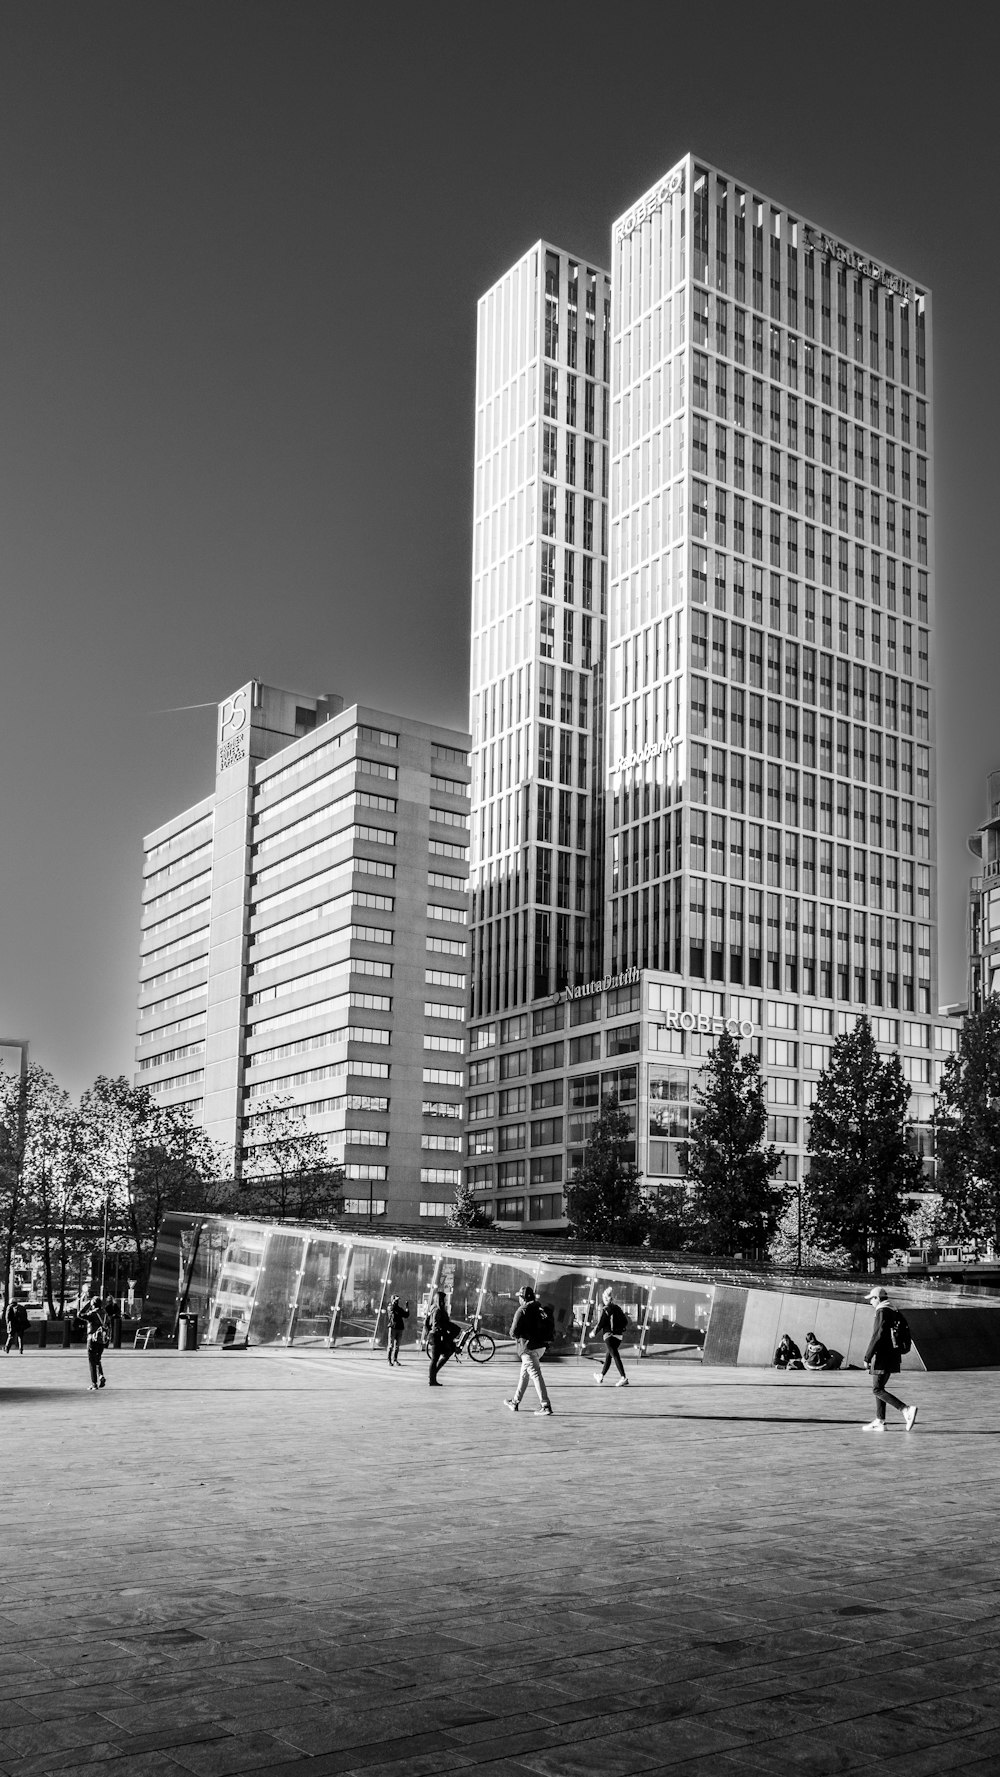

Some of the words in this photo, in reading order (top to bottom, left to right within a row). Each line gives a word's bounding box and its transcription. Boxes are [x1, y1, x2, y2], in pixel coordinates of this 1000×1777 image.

[614, 172, 683, 241] ROBECO
[565, 966, 640, 1001] NautaDutilh
[665, 1008, 756, 1039] ROBECO
